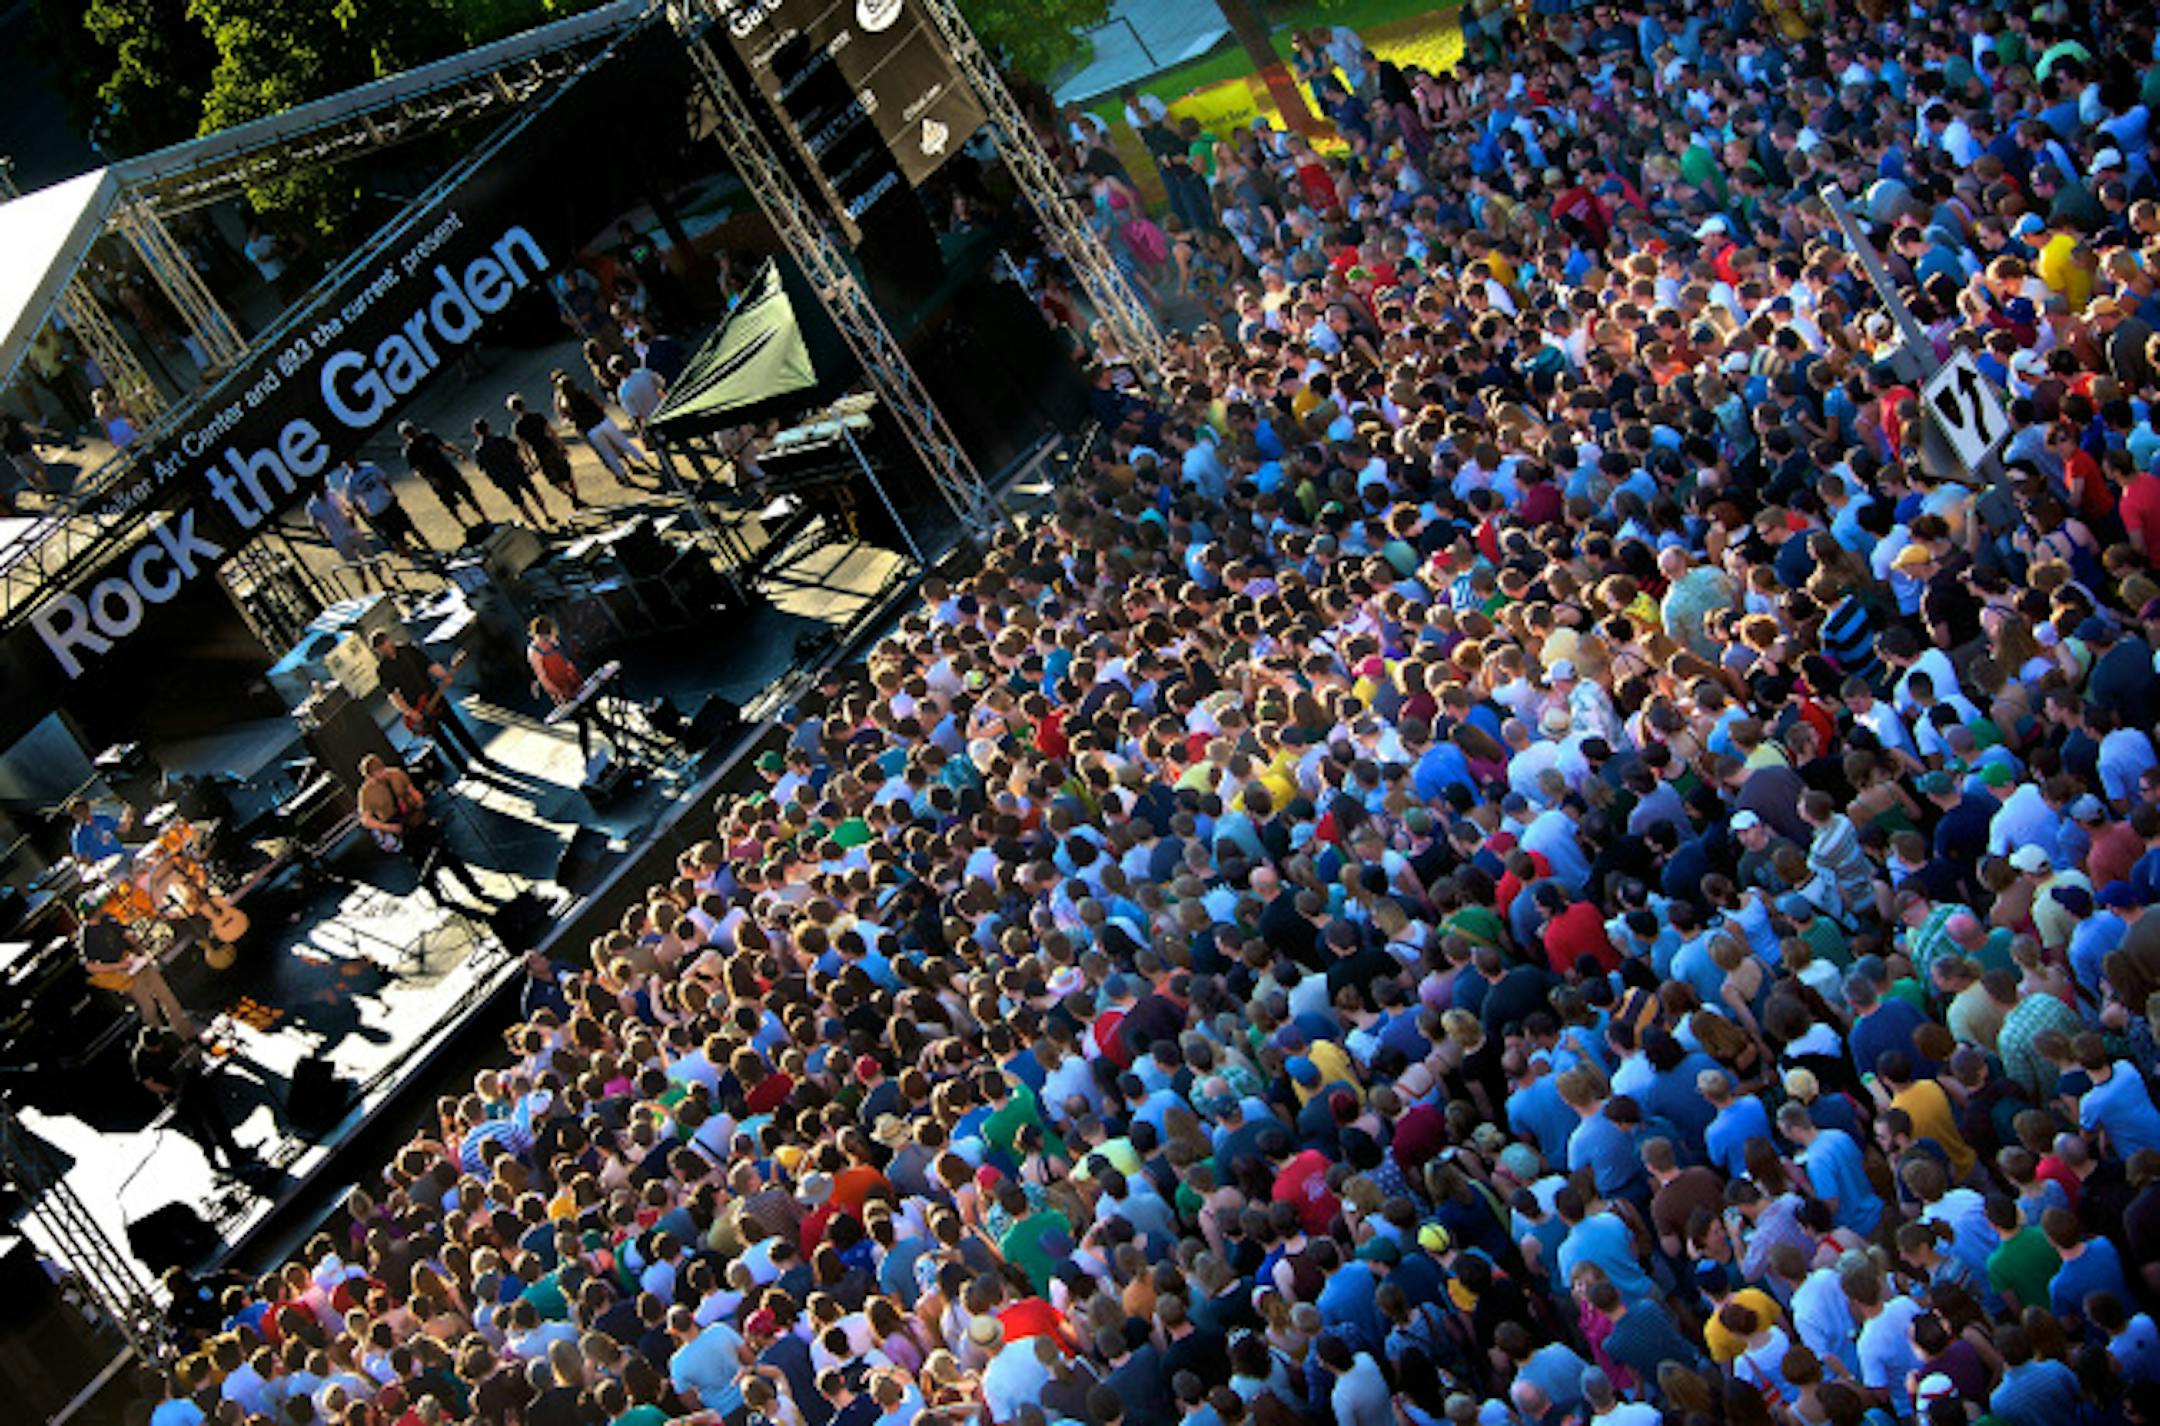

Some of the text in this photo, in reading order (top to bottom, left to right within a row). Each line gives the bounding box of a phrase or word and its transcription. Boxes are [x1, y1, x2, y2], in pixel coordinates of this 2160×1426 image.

[31, 226, 549, 679] Rock the Garden
[153, 452, 187, 486] Art
[181, 402, 244, 457] Center
[244, 368, 280, 407] and
[311, 318, 344, 348] the
[400, 210, 464, 276] present
